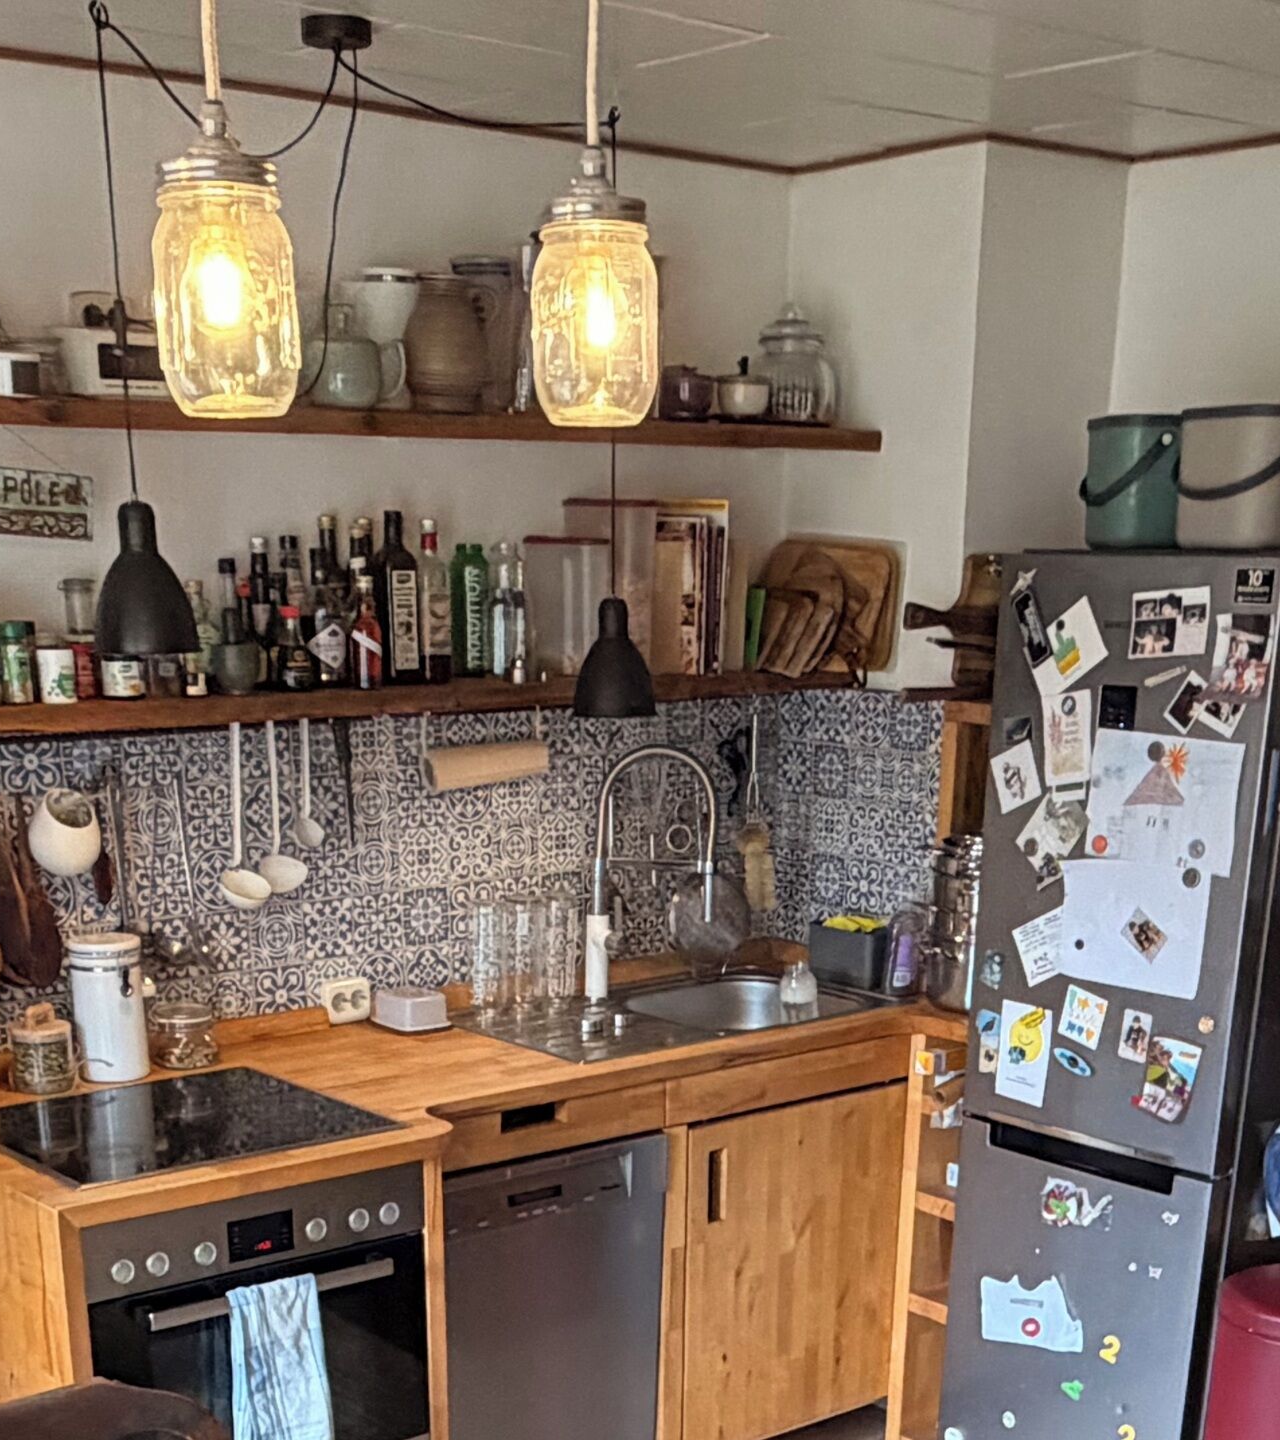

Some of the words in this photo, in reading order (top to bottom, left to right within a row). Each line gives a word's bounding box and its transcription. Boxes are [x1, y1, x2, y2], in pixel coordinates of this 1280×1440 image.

[1247, 569, 1264, 587] 10
[464, 565, 482, 669] TRADITION
[1098, 1334, 1121, 1365] 2
